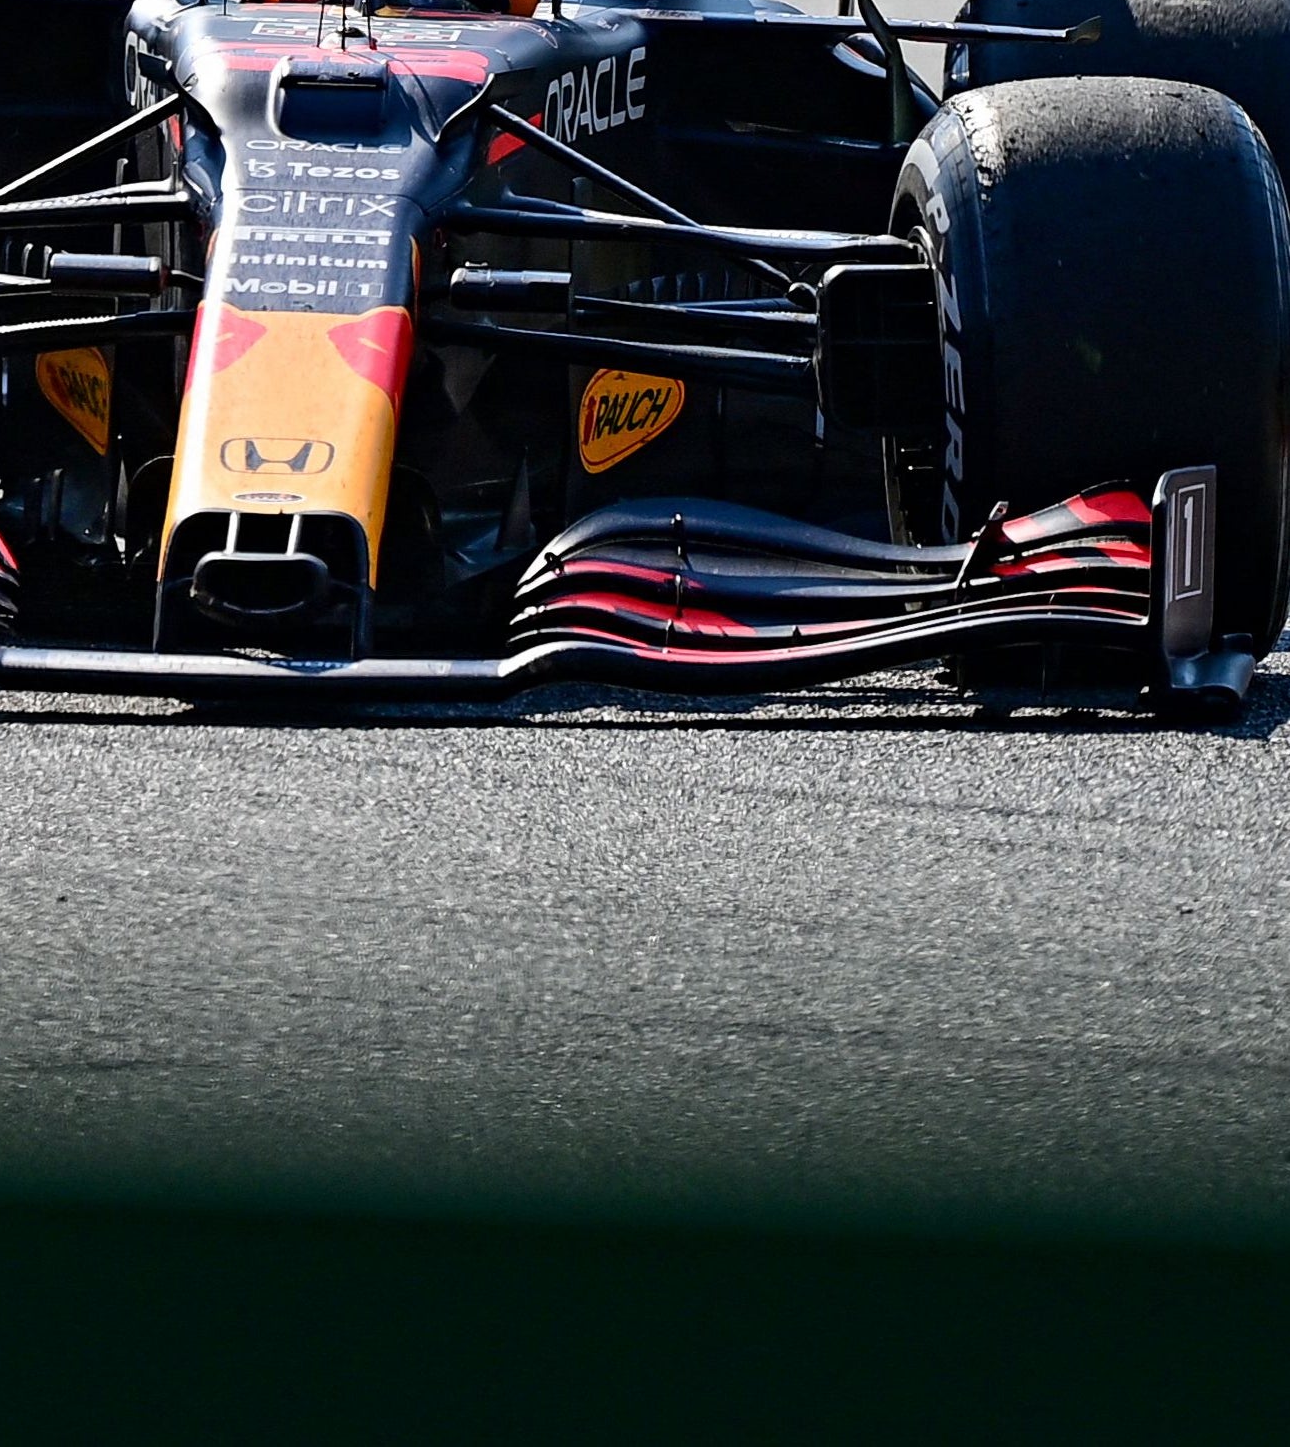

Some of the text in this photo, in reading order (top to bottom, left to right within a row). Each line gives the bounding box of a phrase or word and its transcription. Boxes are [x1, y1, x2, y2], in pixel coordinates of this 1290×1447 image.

[543, 45, 647, 144] ORACLE
[245, 139, 405, 154] ORACLE
[287, 161, 402, 181] Tezos
[232, 225, 394, 246] PIRELLI
[227, 253, 389, 270] infinitum
[223, 277, 338, 296] Mobil
[593, 386, 673, 441] RAUCH
